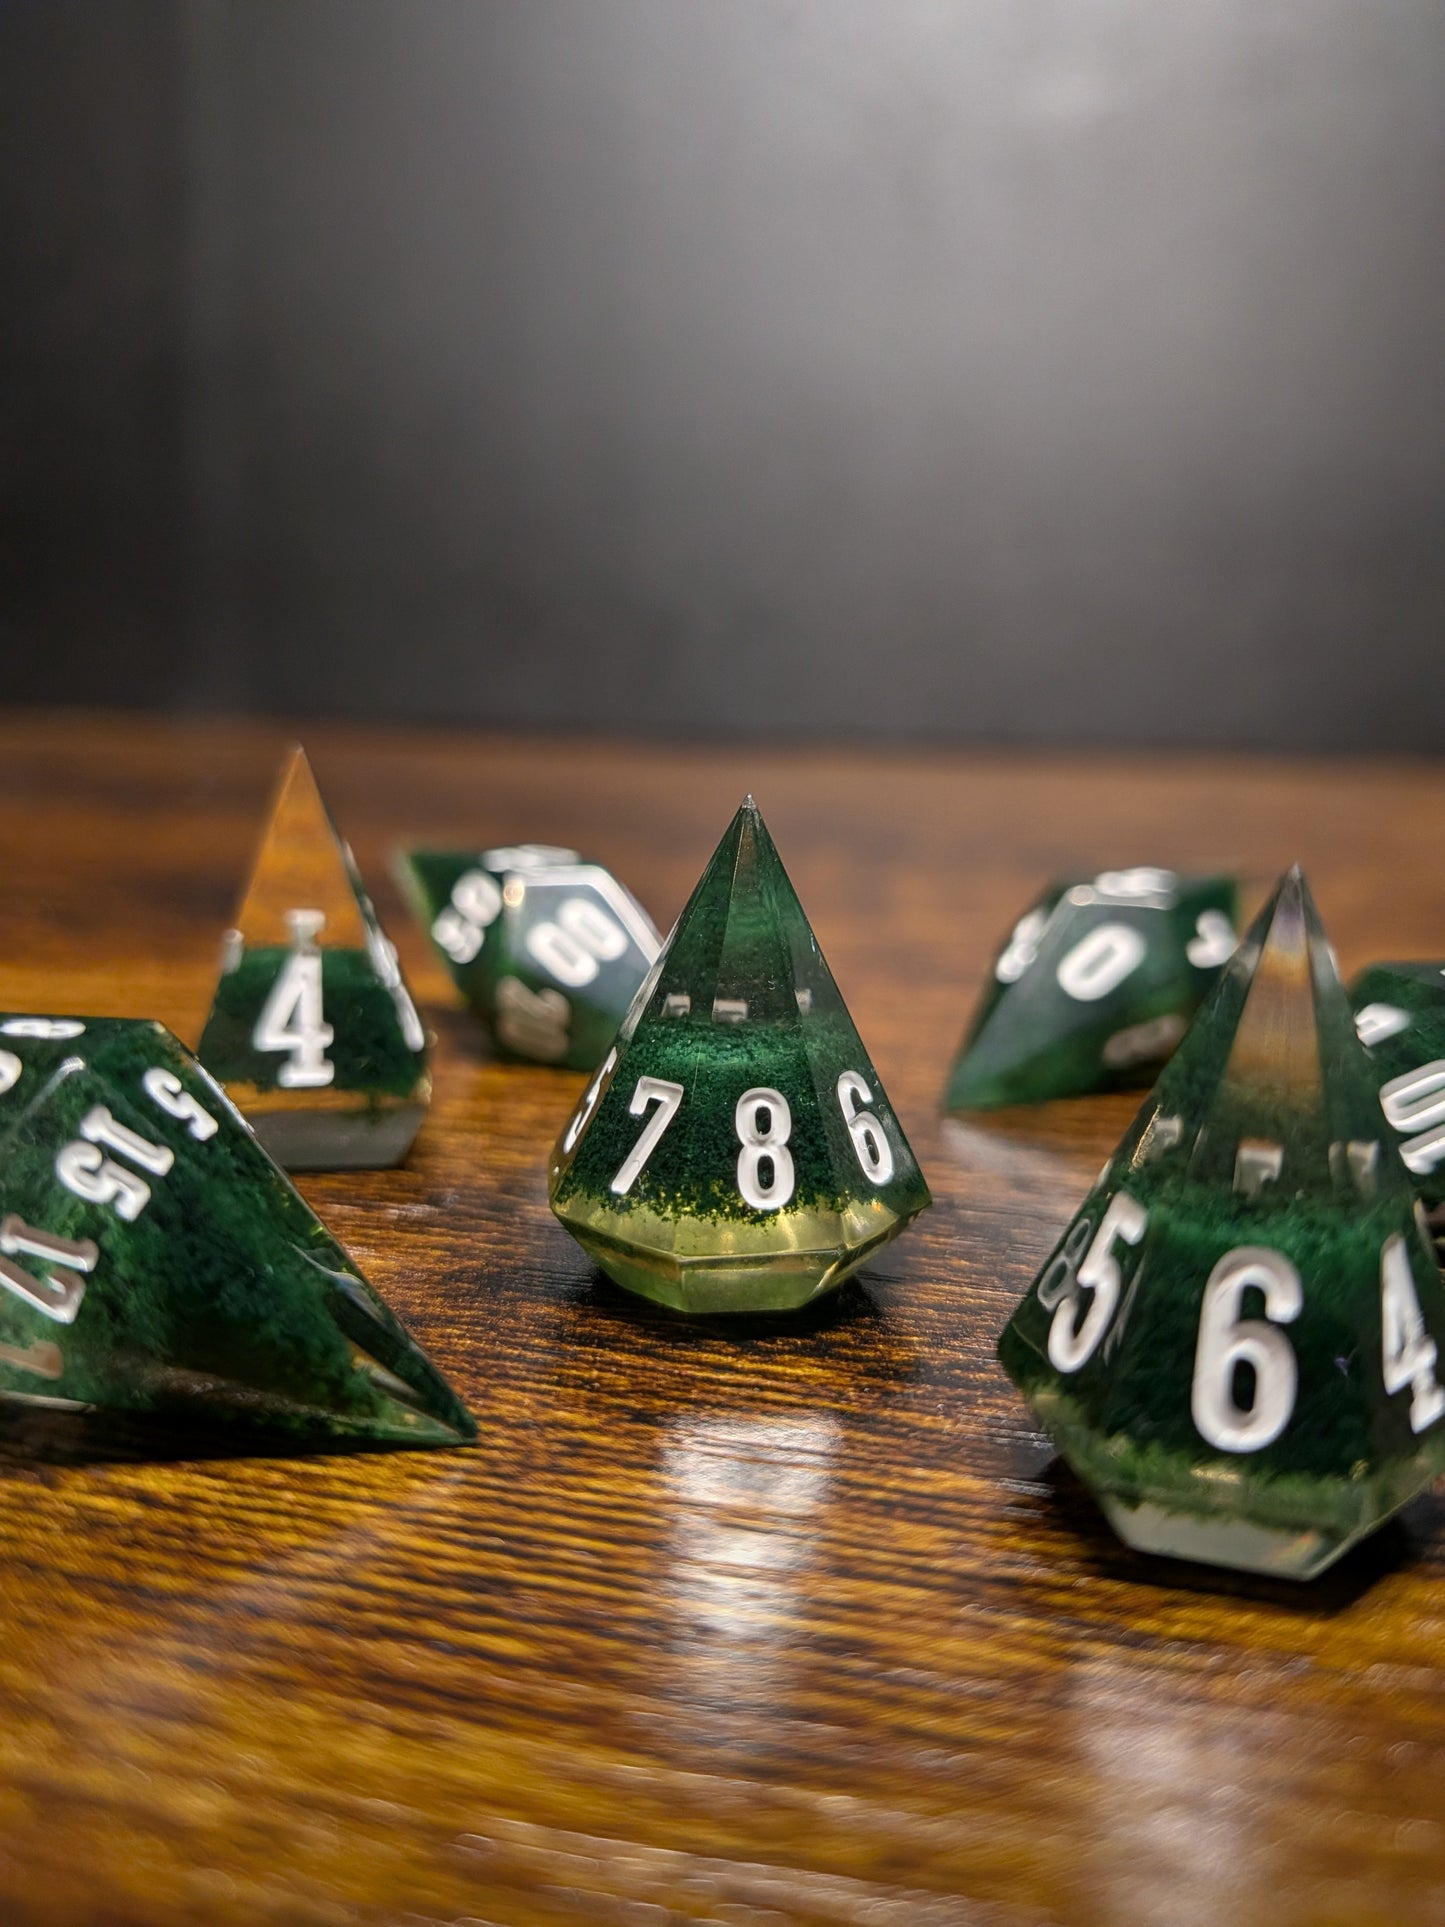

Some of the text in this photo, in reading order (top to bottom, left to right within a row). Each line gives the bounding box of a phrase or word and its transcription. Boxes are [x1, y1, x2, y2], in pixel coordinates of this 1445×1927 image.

[527, 898, 628, 988] 00
[1057, 922, 1145, 1001] 0
[252, 955, 335, 1088] 4
[56, 1104, 175, 1222] 15
[143, 1067, 218, 1141] 5
[610, 1075, 684, 1195] 7
[735, 1087, 795, 1210] 8
[837, 1070, 894, 1186] 6
[1048, 1190, 1148, 1373] 5
[1380, 1232, 1445, 1434] 4
[1191, 1245, 1303, 1453] 6
